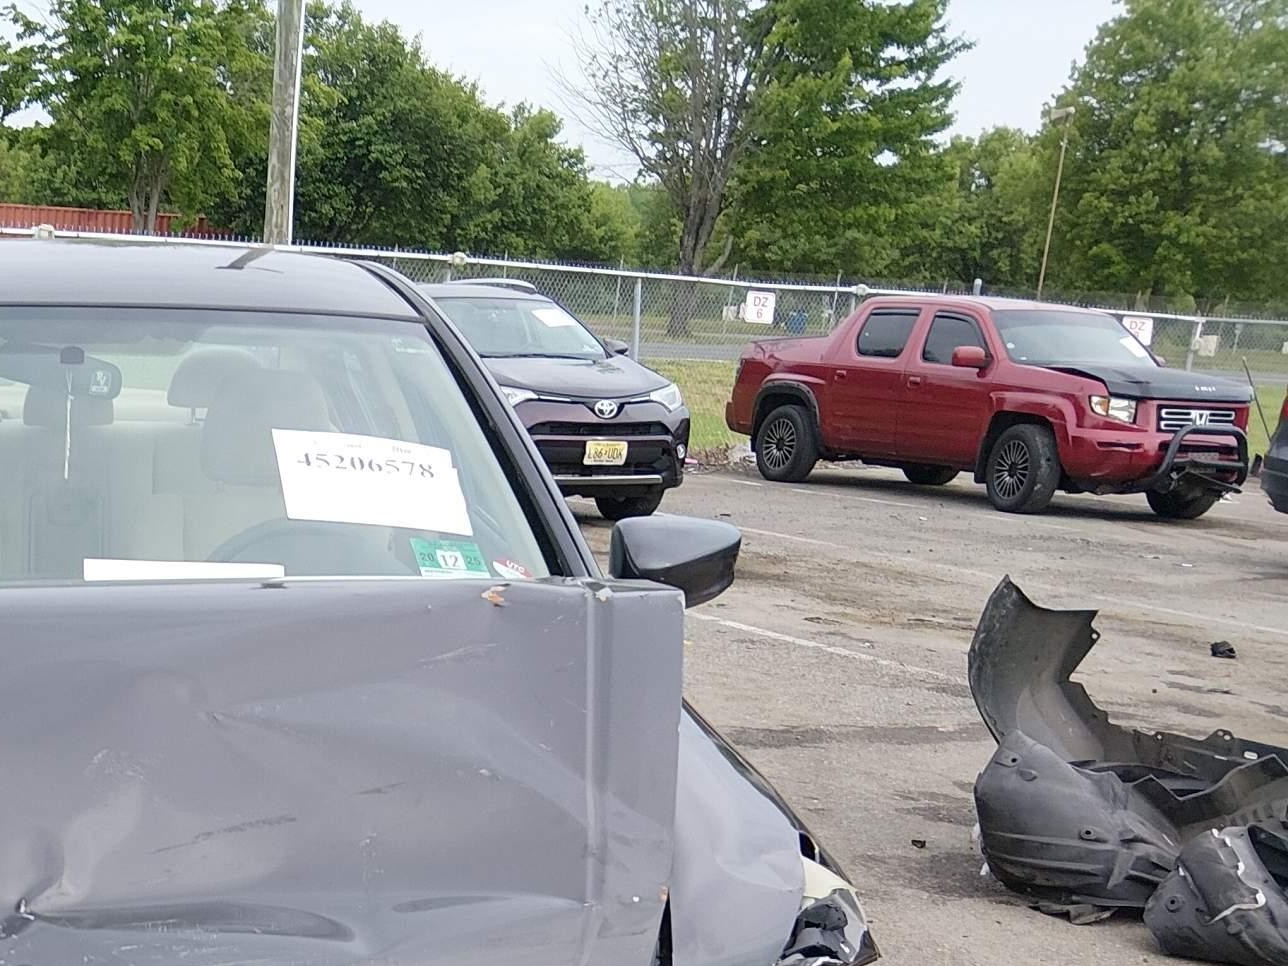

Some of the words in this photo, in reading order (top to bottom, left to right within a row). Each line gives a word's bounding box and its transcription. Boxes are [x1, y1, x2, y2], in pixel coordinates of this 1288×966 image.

[753, 296, 769, 308] DZ
[757, 308, 764, 319] 6
[1129, 319, 1146, 332] DZ
[296, 452, 435, 479] 45206578
[440, 554, 460, 568] 12
